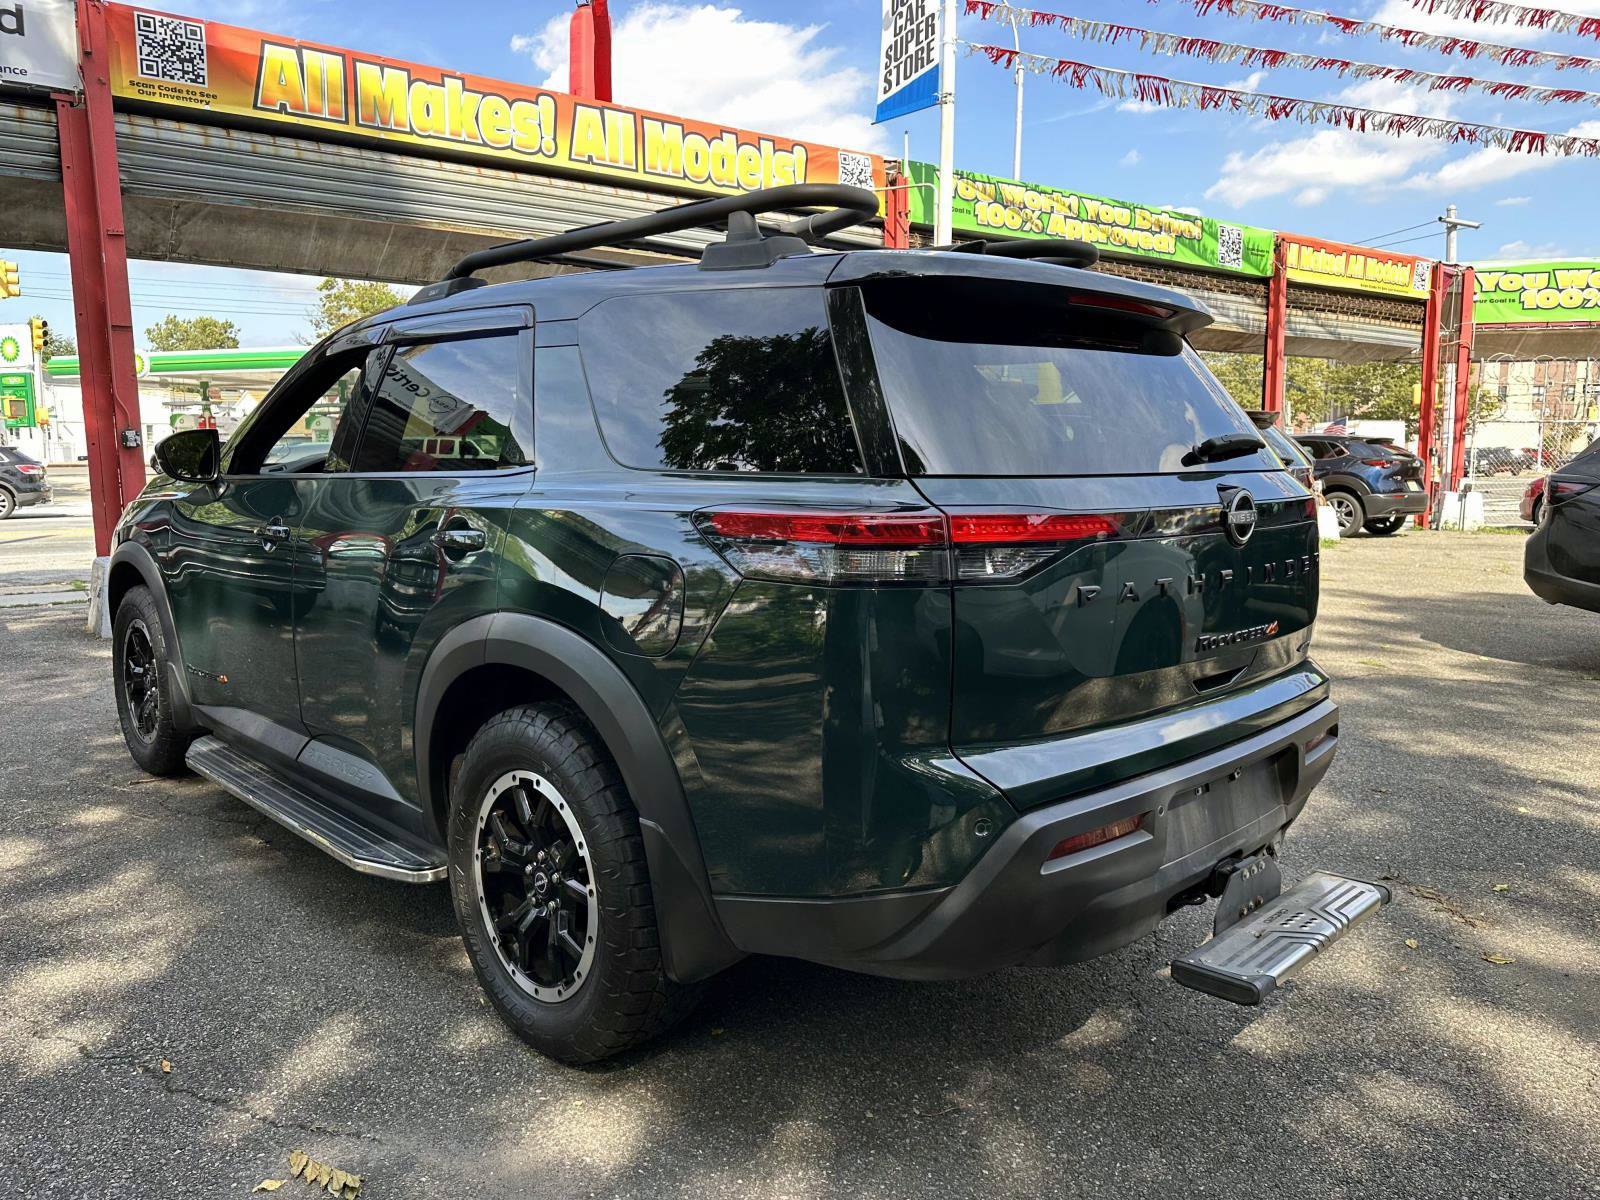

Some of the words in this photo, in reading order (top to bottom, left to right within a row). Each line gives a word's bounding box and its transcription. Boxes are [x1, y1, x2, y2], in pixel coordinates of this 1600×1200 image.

[893, 0, 926, 38] CAR
[885, 12, 936, 71] SUPER
[883, 37, 935, 95] STORE
[129, 80, 156, 90] Scan
[157, 84, 184, 95] Code
[186, 88, 197, 97] to
[199, 91, 218, 100] See
[137, 88, 157, 97] Our
[159, 91, 211, 106] Inventory
[253, 41, 349, 125] All
[352, 58, 559, 158] Makes!
[569, 102, 638, 172] All
[641, 115, 807, 191] Models!
[996, 181, 1080, 217] Work!
[1079, 196, 1132, 227] You
[974, 201, 1044, 233] 100%
[1045, 213, 1177, 254] Approved!
[1300, 245, 1347, 278] Makes!
[1346, 253, 1365, 280] All
[1365, 256, 1412, 288] Models!
[1475, 270, 1551, 292] You
